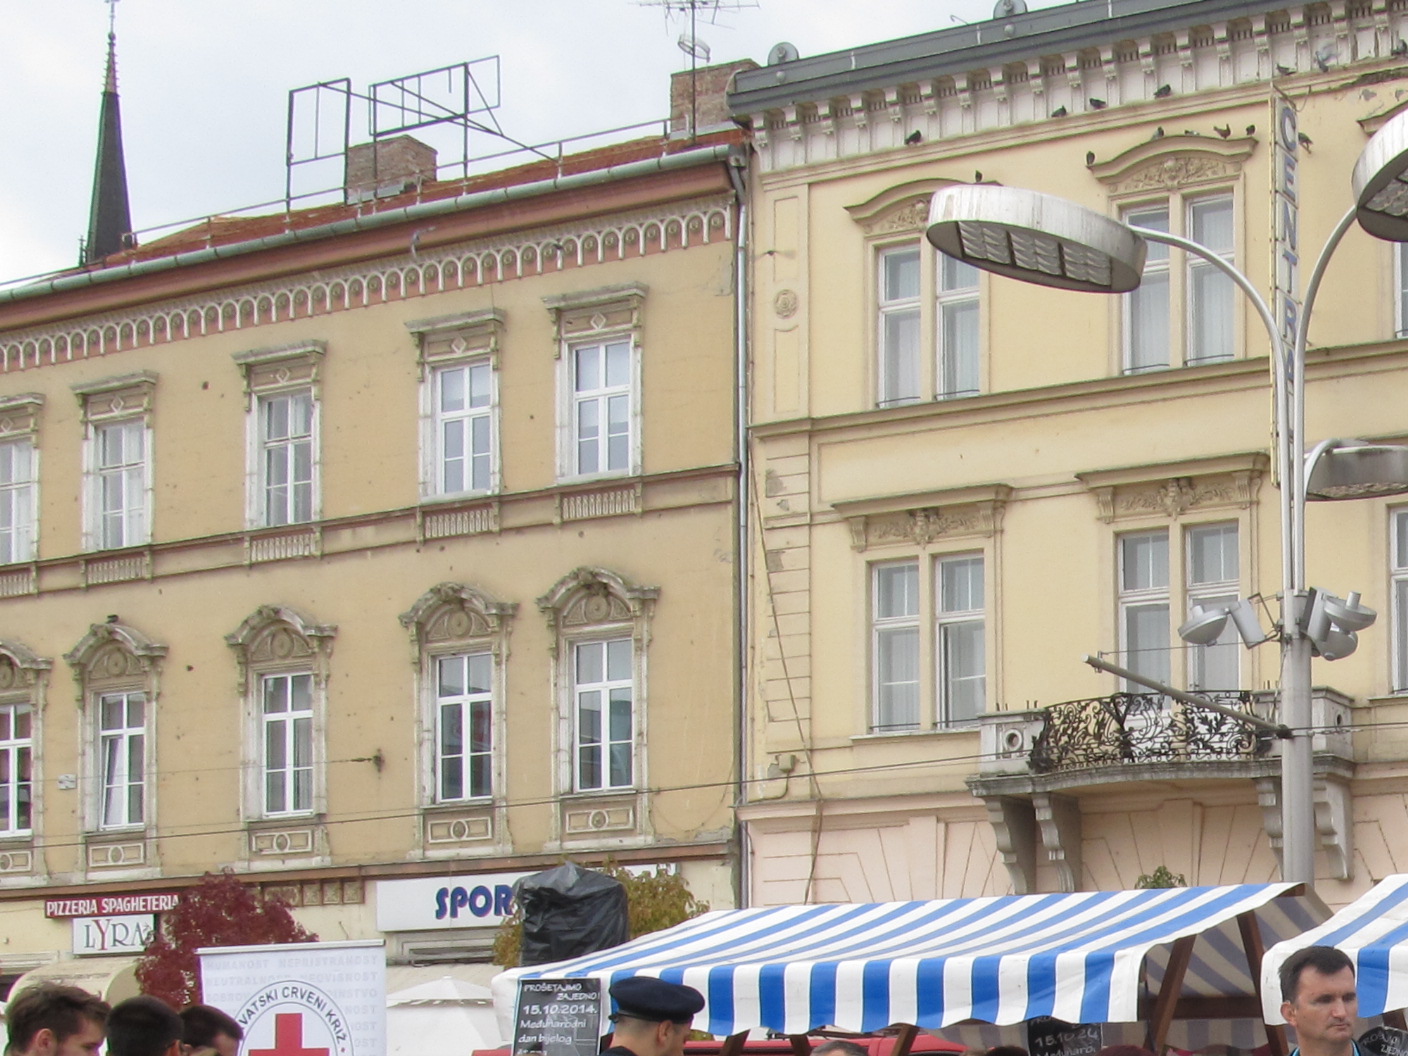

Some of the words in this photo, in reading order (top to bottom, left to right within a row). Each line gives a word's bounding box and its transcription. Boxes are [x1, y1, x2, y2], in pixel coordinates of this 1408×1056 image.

[1280, 106, 1298, 440] CENTRA
[46, 899, 98, 916] PIZZERIA
[102, 894, 179, 913] SPAGHETERIA
[435, 884, 514, 920] SPOR
[84, 918, 147, 951] LYRA
[237, 990, 279, 1031] VATSKI
[281, 985, 328, 1011] CRVENI
[325, 1008, 348, 1045] KRIŽ
[522, 1004, 598, 1015] 15.10.2014.
[518, 1034, 537, 1043] dan
